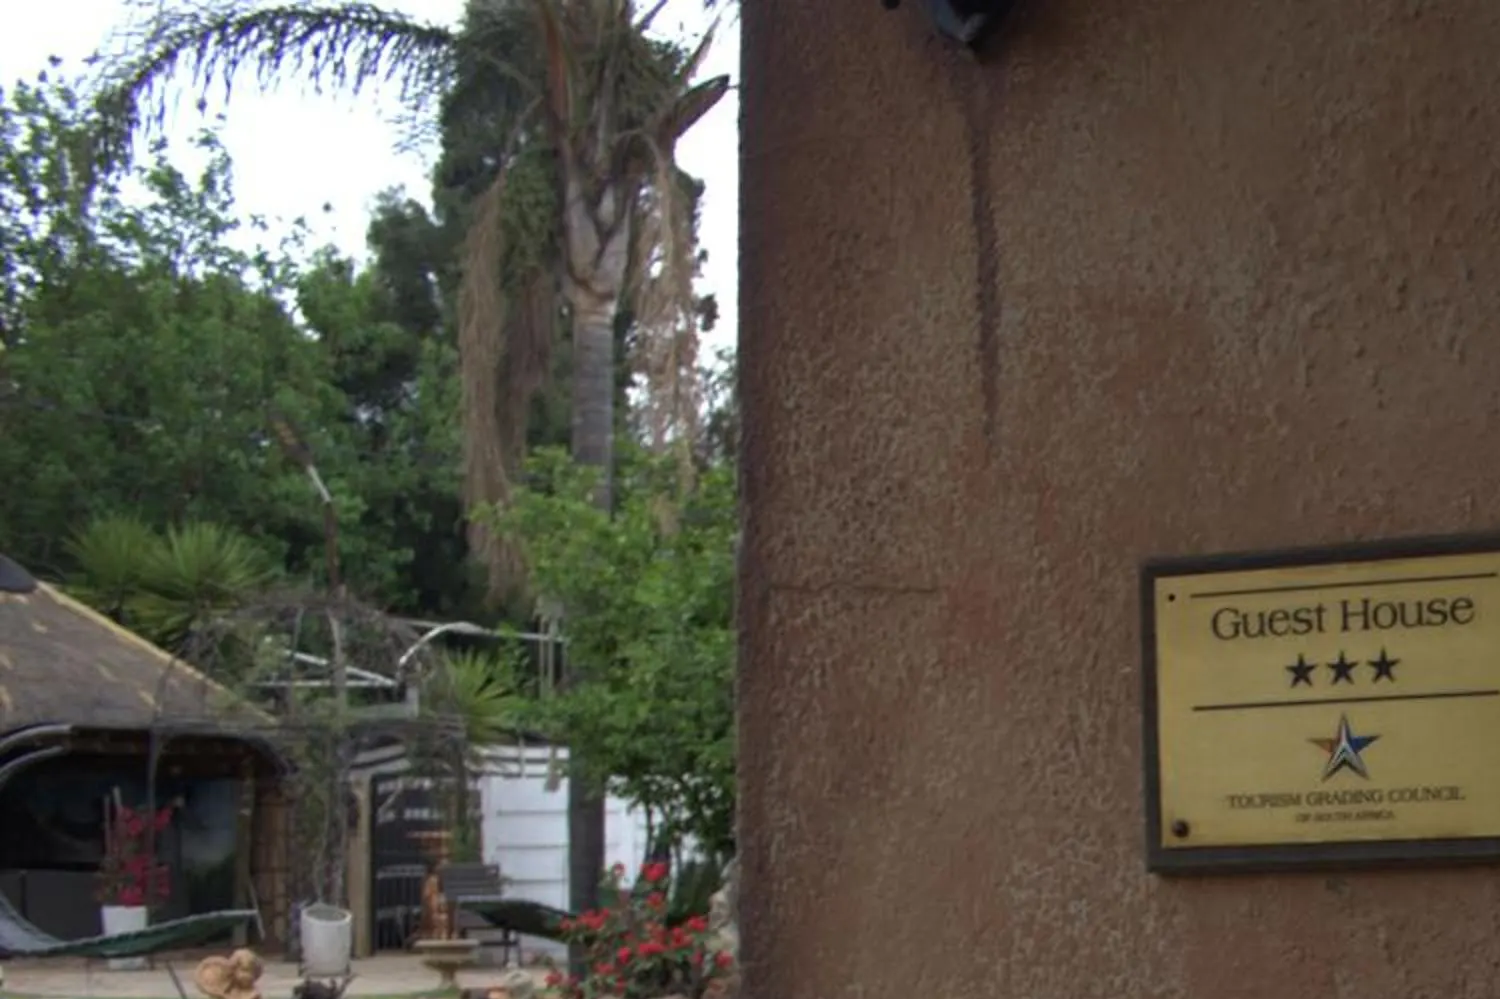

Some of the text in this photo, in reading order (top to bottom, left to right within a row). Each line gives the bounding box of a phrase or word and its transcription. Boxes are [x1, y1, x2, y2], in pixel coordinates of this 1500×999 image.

[1211, 595, 1476, 640] Guest House
[1226, 785, 1466, 809] TOURISM GRADING COUNCIL
